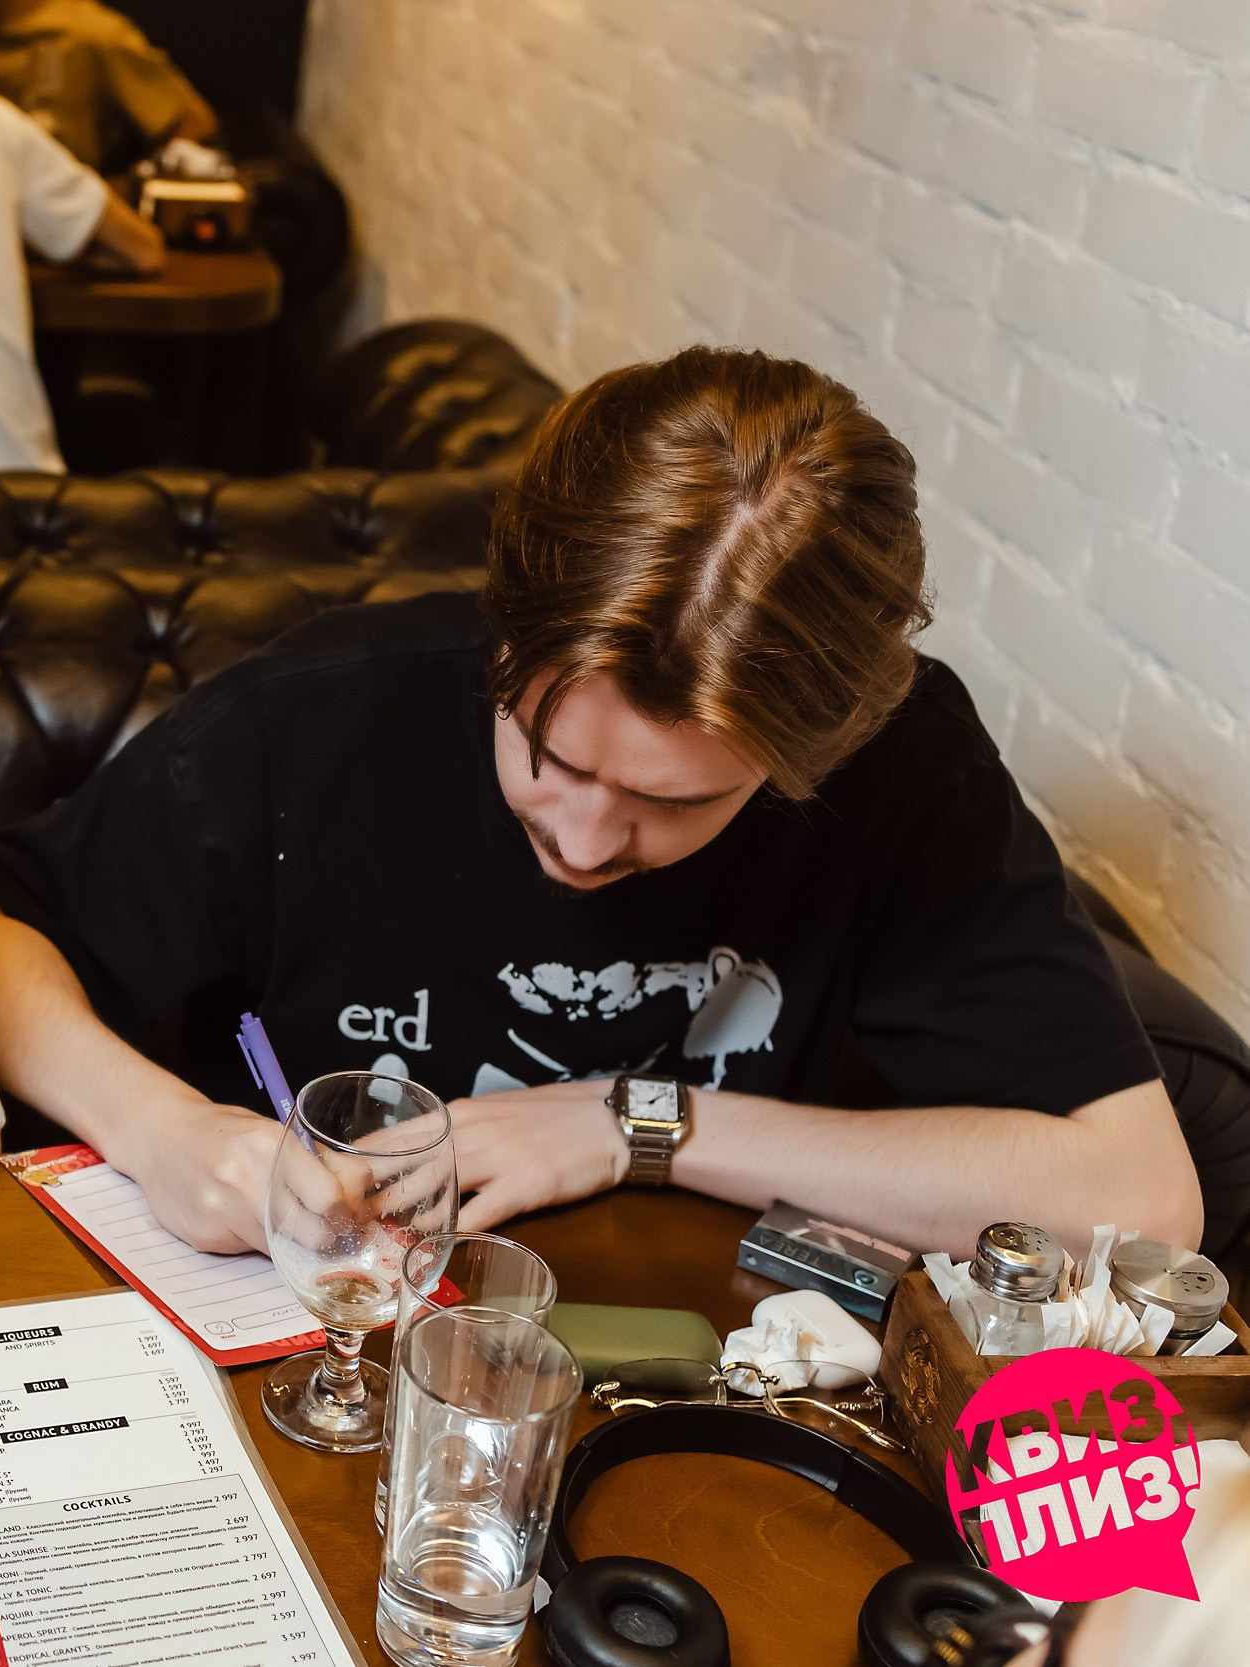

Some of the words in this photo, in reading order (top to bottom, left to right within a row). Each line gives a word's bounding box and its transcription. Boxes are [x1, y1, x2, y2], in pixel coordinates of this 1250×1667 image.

[337, 989, 432, 1051] erd
[3, 1343, 23, 1351] AND
[23, 1339, 56, 1348] SPIRITS
[31, 1380, 60, 1391] RUM
[5, 1427, 57, 1441] COGNAC
[58, 1425, 70, 1434] &
[71, 1418, 122, 1432] BRANDY
[192, 1435, 209, 1443] 697
[197, 1442, 213, 1450] 397
[200, 1450, 217, 1458] 997
[203, 1457, 220, 1465] 497
[208, 1465, 224, 1473] 297
[220, 1492, 239, 1501] 997
[61, 1494, 132, 1512] COCKTAILS
[232, 1515, 250, 1523] 697
[240, 1533, 259, 1541] 997
[11, 1546, 48, 1557] SUNRISE
[250, 1552, 268, 1560] 797
[259, 1570, 278, 1579] 697
[24, 1585, 52, 1596] TONIC
[268, 1590, 288, 1599] 997
[278, 1610, 298, 1619] 597
[0, 1630, 35, 1643] APEROL
[35, 1626, 68, 1636] SPRITZ
[288, 1630, 308, 1640] 597
[8, 1650, 51, 1663] TROPICAL
[51, 1644, 91, 1656] GRANT'S
[298, 1651, 318, 1661] 997
